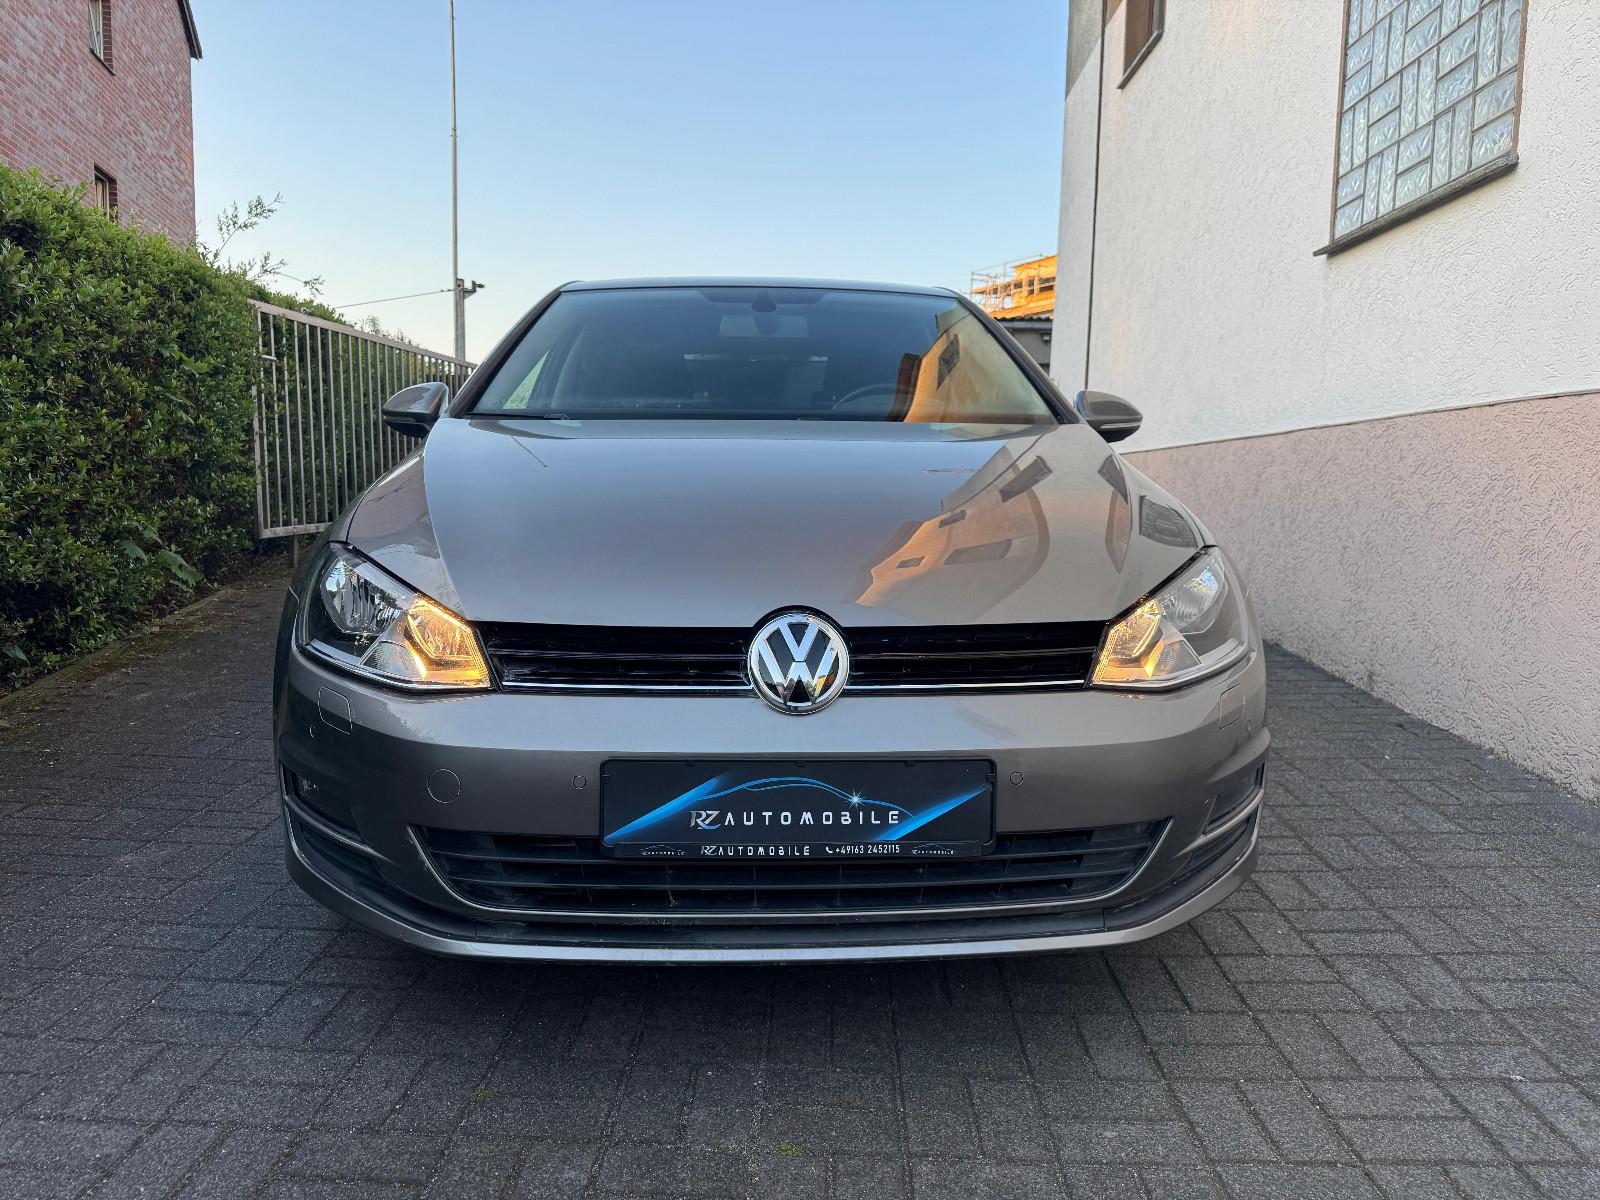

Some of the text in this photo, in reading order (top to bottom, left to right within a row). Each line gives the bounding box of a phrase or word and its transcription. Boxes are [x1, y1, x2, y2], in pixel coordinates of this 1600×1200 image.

[725, 811, 900, 826] AUTOMOBILE
[718, 846, 810, 856] AUTOMOBILE
[836, 845, 864, 855] +49163
[867, 844, 900, 854] 2452115
